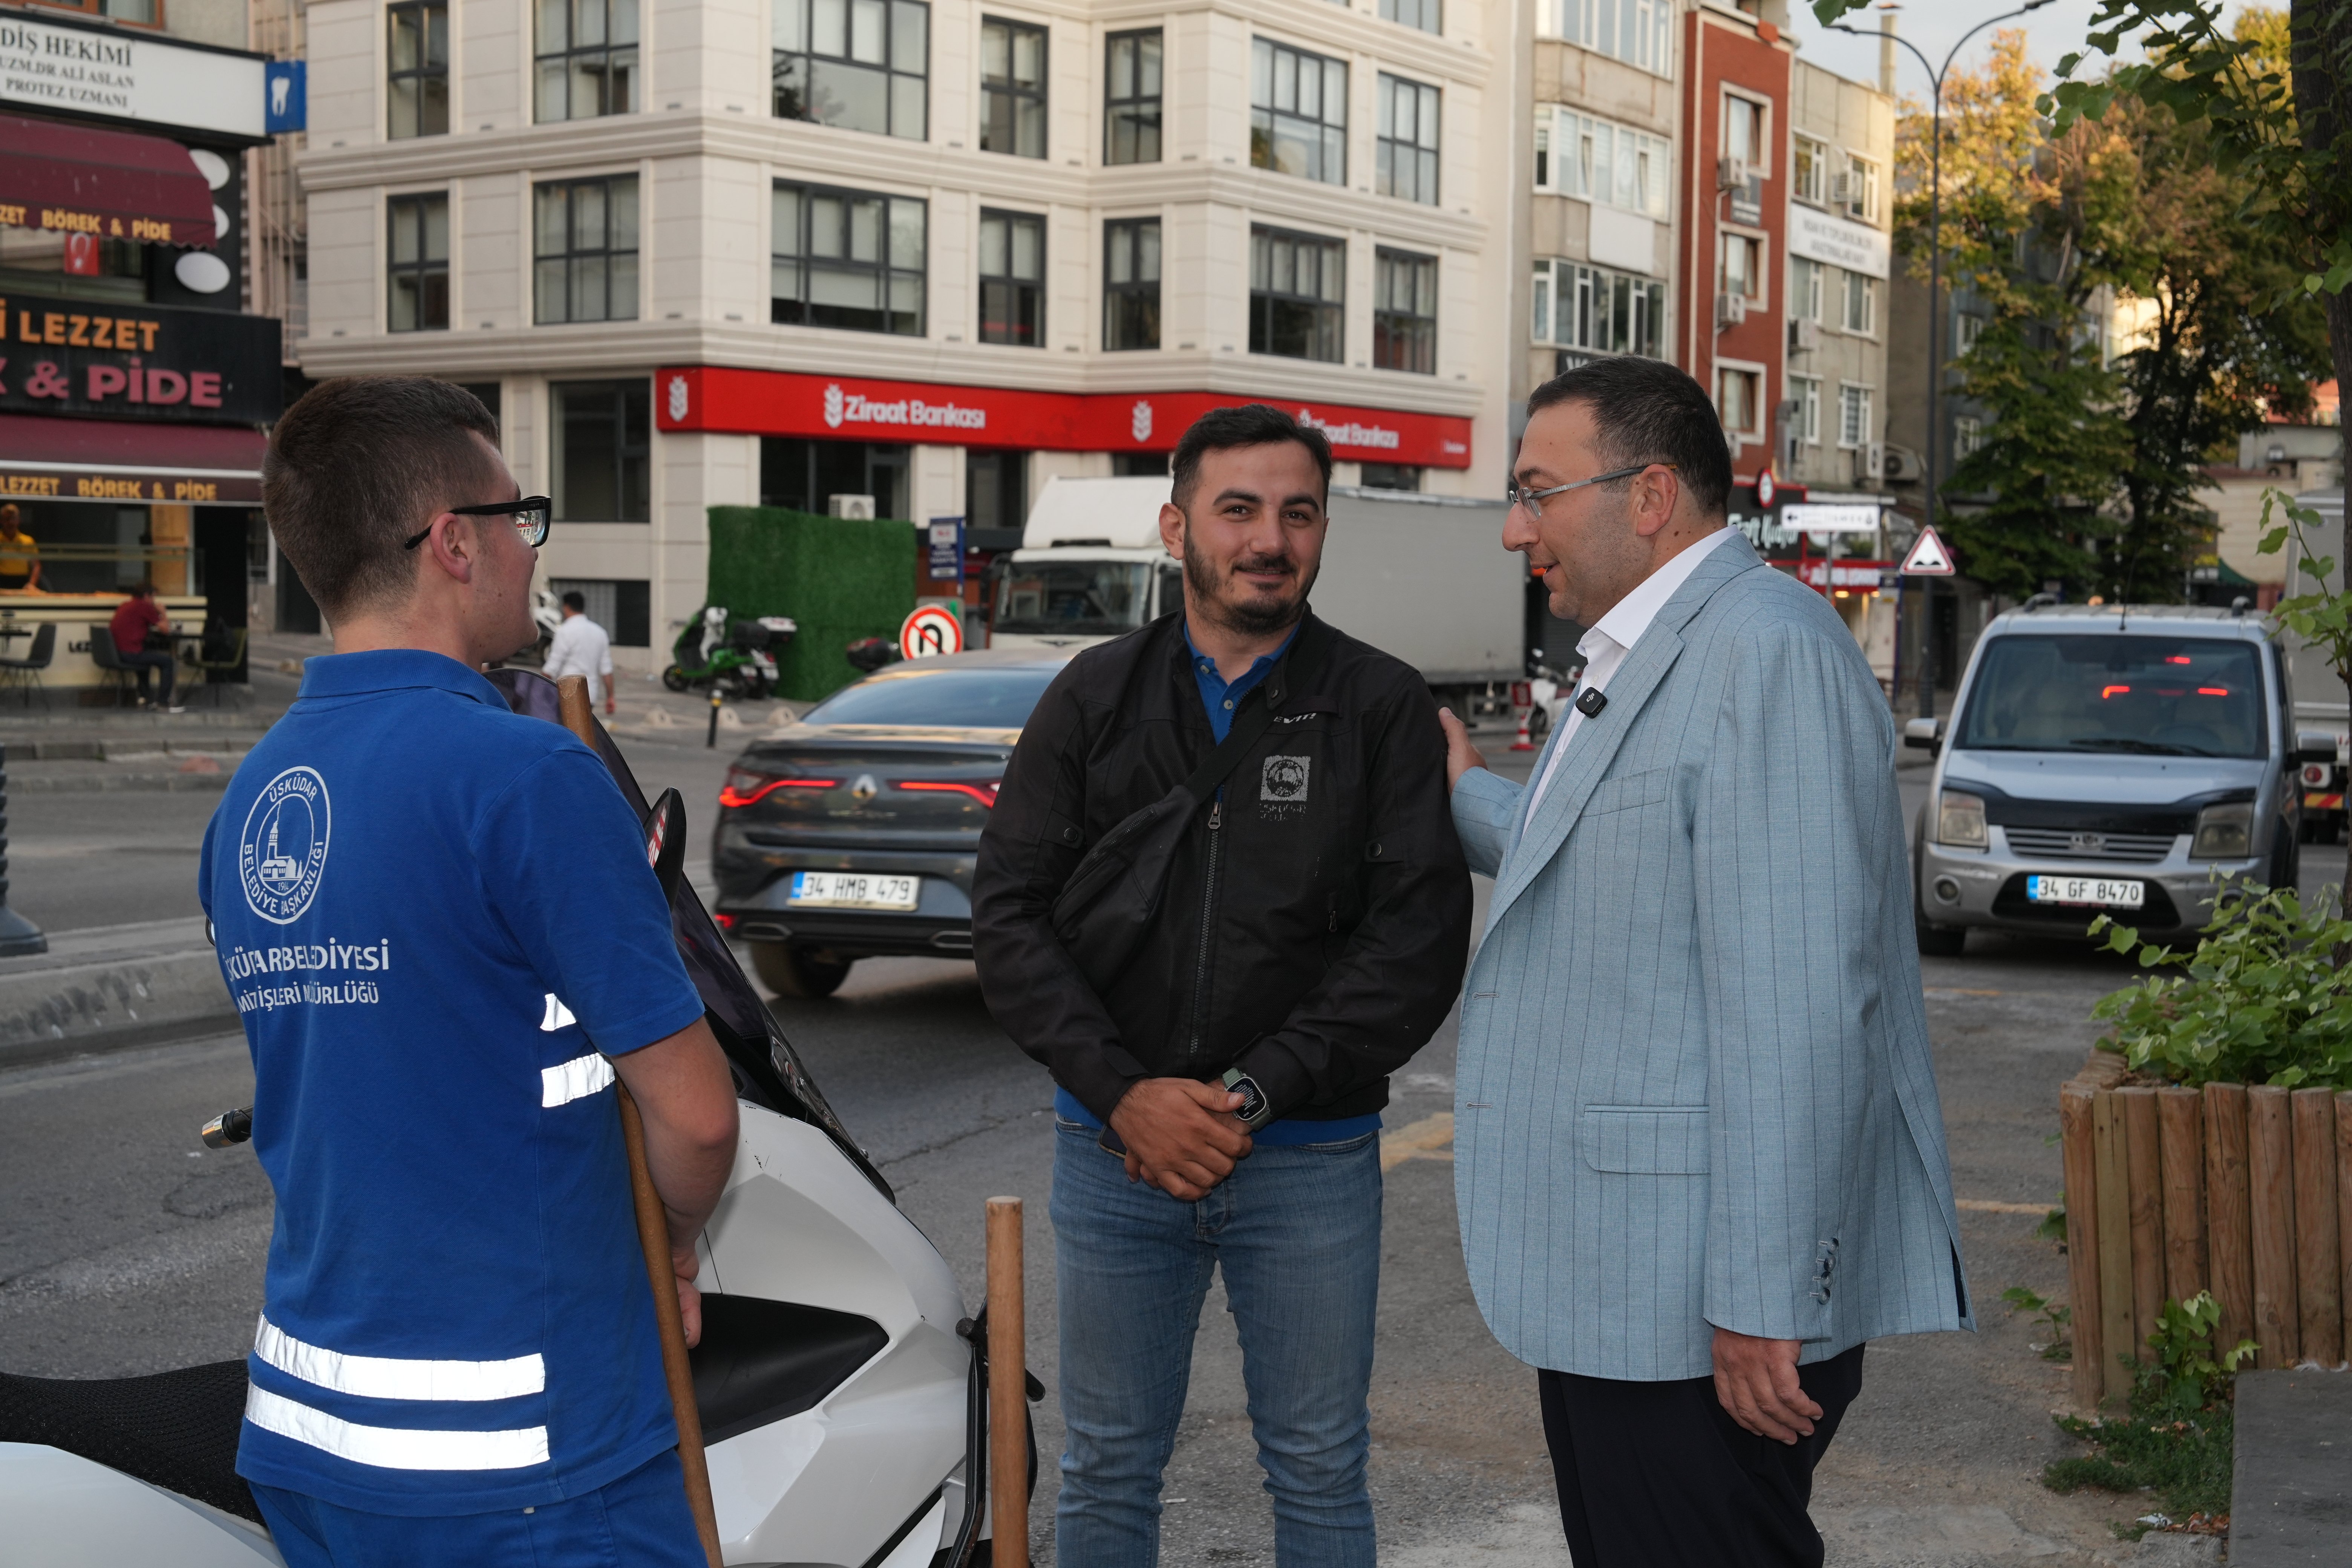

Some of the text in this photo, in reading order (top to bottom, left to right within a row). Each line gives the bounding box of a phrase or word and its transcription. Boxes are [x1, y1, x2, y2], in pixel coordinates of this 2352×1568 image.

[2, 24, 132, 67] DİŞ HEKİMİ
[6, 77, 128, 109] PROTEZ UZMANI
[60, 64, 85, 81] ALİ
[87, 69, 135, 89] ASLAN
[41, 207, 101, 233] BÖREK
[110, 217, 124, 236] &
[132, 216, 172, 242] PİDE
[19, 310, 161, 352] LEZZET
[25, 360, 70, 399] &
[87, 356, 223, 409] PİDE
[844, 394, 986, 429] Ziraat Bankası
[0, 474, 217, 501] LEZZET BÖREK & PİDE
[269, 773, 317, 802] ÜSKÜDAR
[244, 844, 278, 914] BELEDİYE
[804, 876, 824, 897] 34
[833, 877, 867, 898] HMB
[876, 879, 910, 900] 479
[2040, 880, 2058, 896] 34
[2068, 881, 2088, 898] GF
[2097, 882, 2139, 901] 8470
[282, 937, 389, 971] BELEDİYESİ
[257, 981, 302, 1011] İŞLERİ
